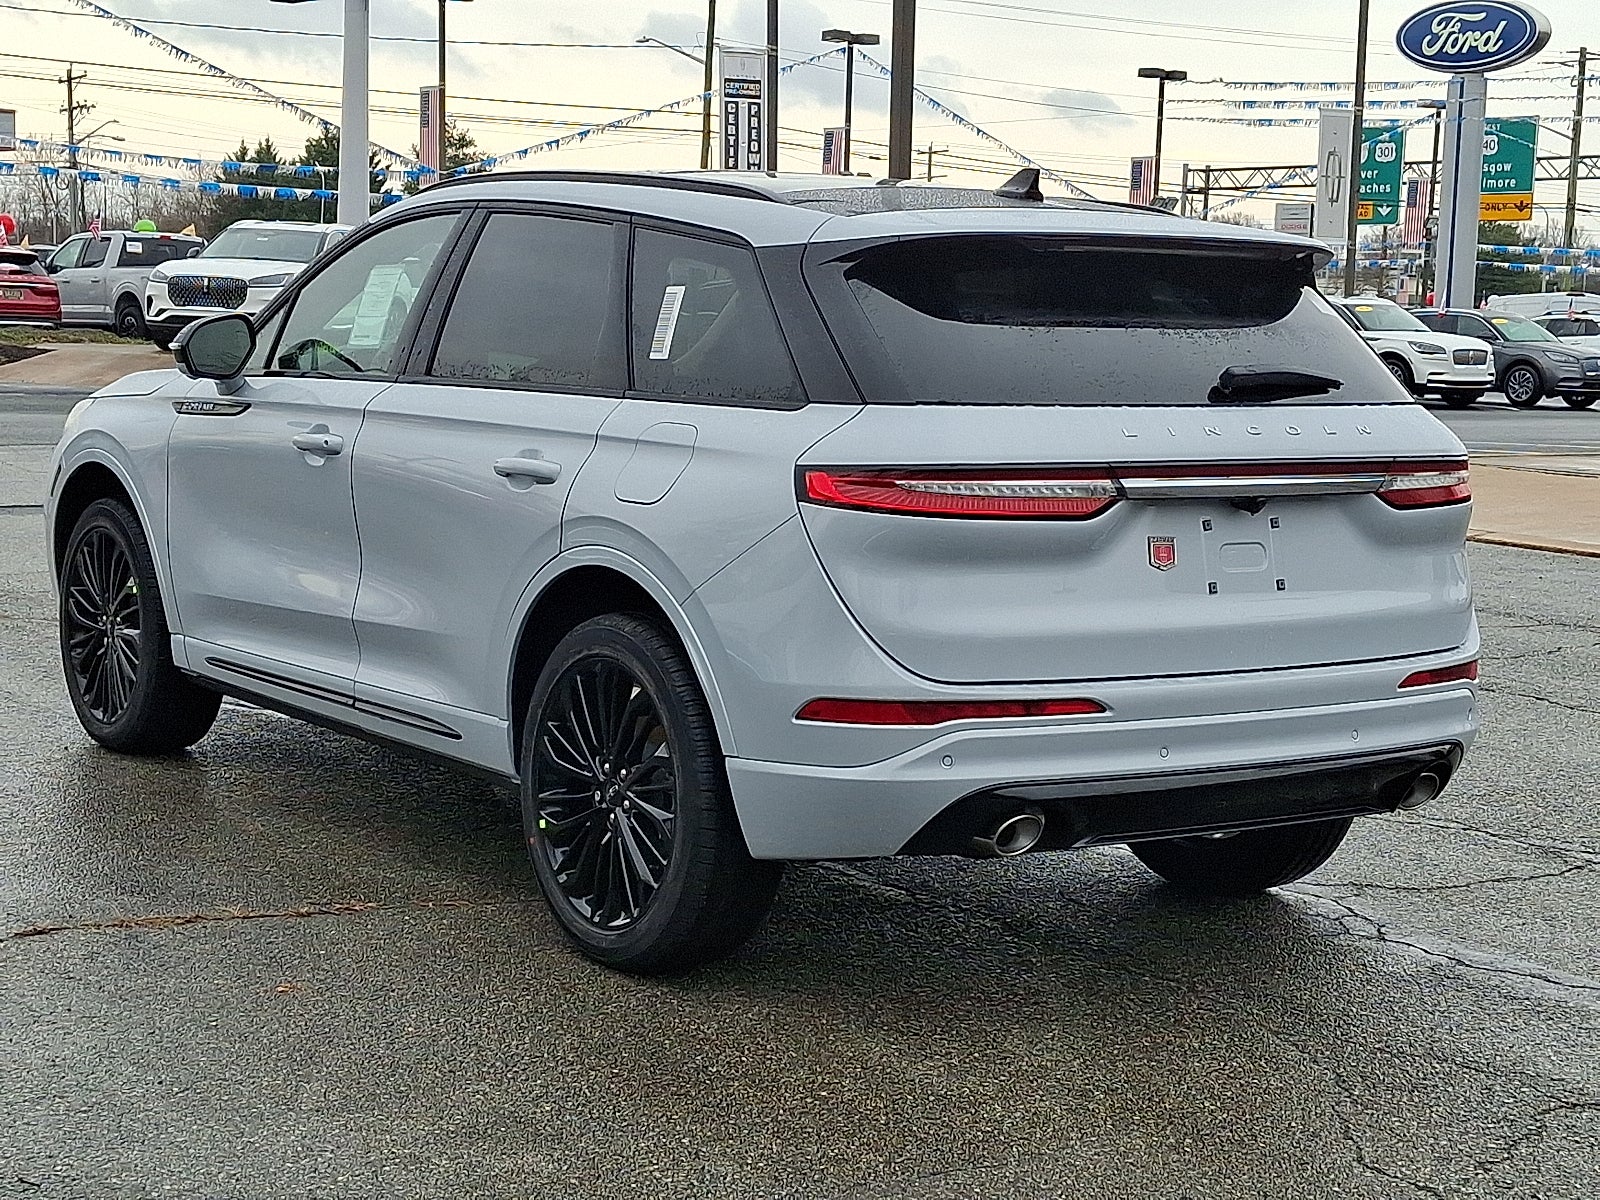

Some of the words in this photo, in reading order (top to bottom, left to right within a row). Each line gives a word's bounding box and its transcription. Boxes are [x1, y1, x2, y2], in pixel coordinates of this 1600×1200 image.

[1422, 12, 1508, 56] Ford
[725, 82, 760, 90] CERTIFIED
[1377, 147, 1394, 158] 301
[1122, 425, 1372, 438] LINCOLN
